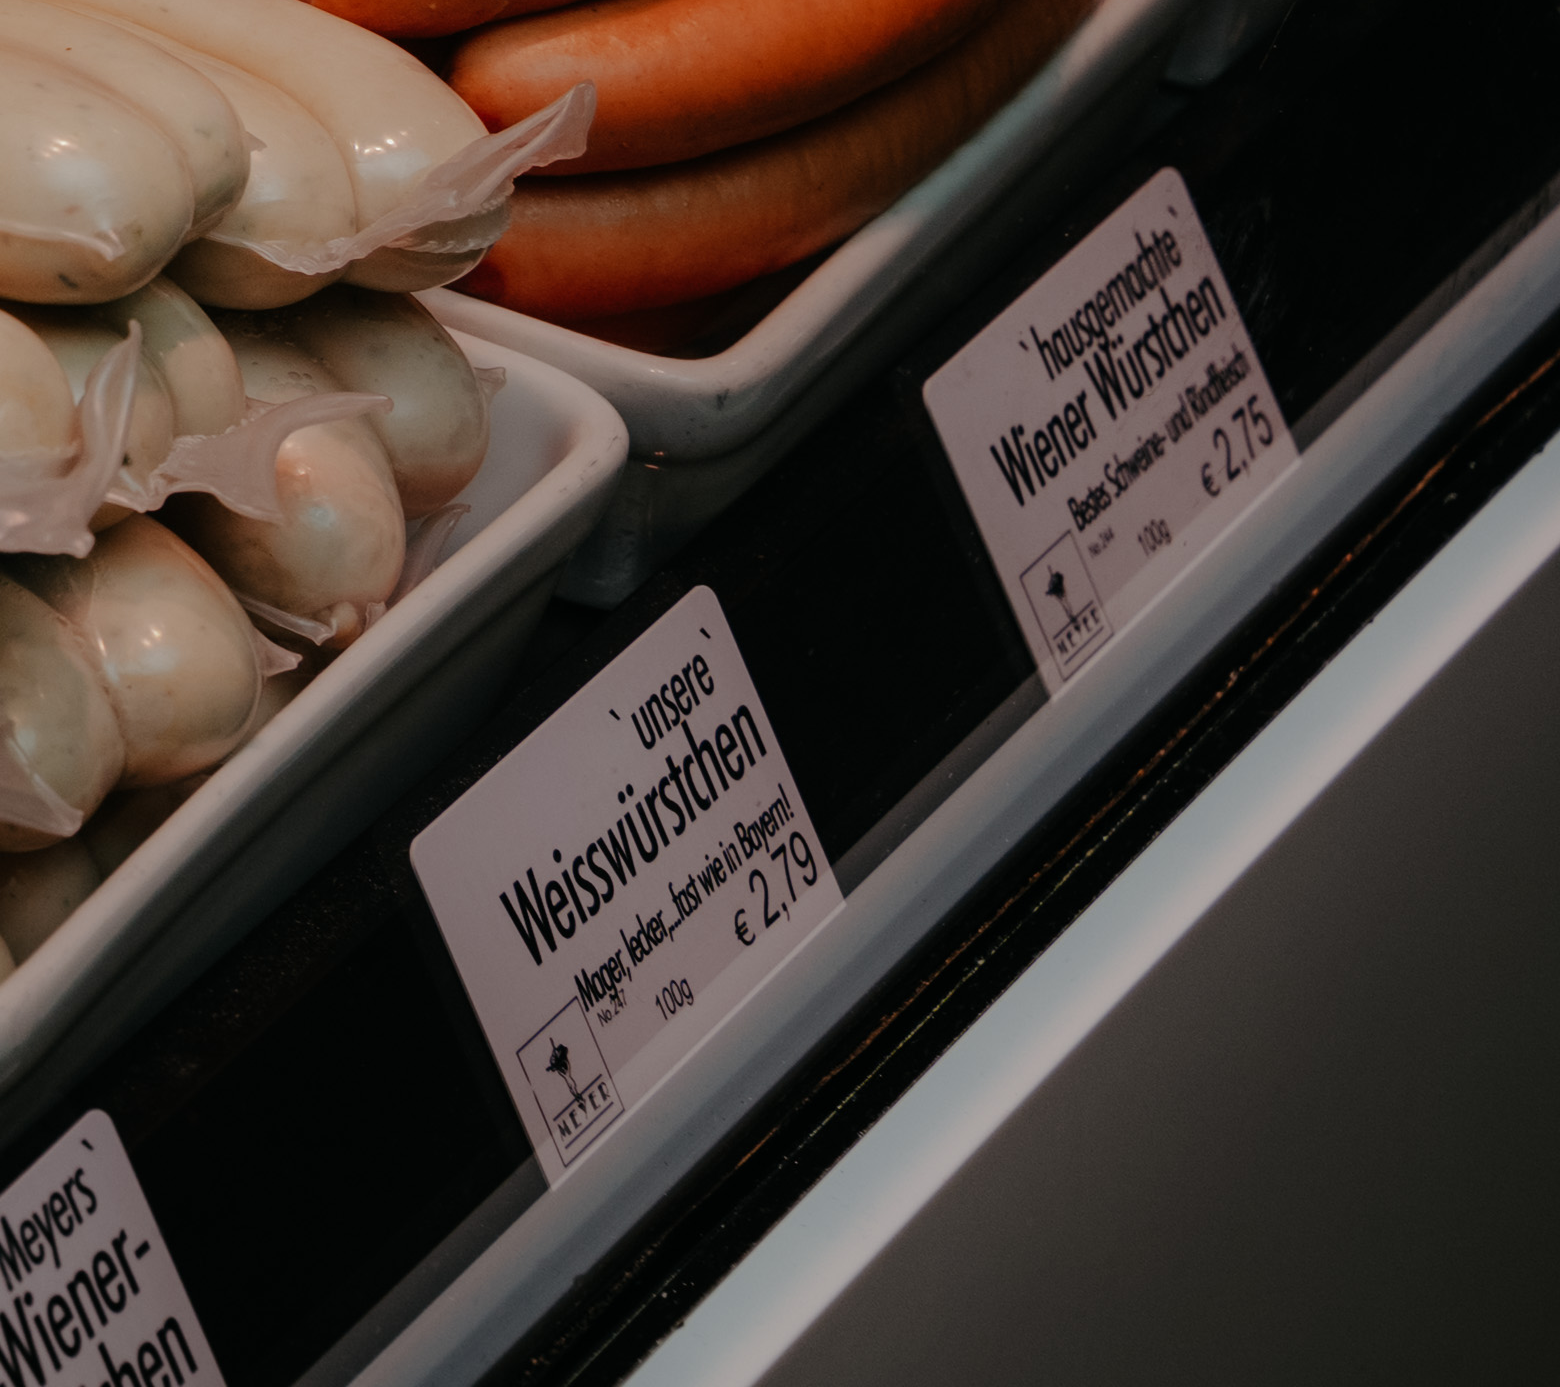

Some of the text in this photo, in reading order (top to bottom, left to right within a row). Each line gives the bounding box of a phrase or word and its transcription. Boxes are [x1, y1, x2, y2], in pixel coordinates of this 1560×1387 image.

[990, 276, 1226, 507] Wiener Würstchen
[1213, 394, 1274, 481] 2,75
[1067, 481, 1113, 532] Bestes
[1138, 519, 1172, 558] 100g
[499, 705, 768, 966] Weisswürstchen
[573, 949, 632, 1012] Mager,
[697, 854, 728, 897] wie
[733, 783, 795, 860] Bayern!
[749, 831, 818, 928] 2,79
[655, 978, 695, 1021] 100g
[557, 1082, 610, 1141] MEYER
